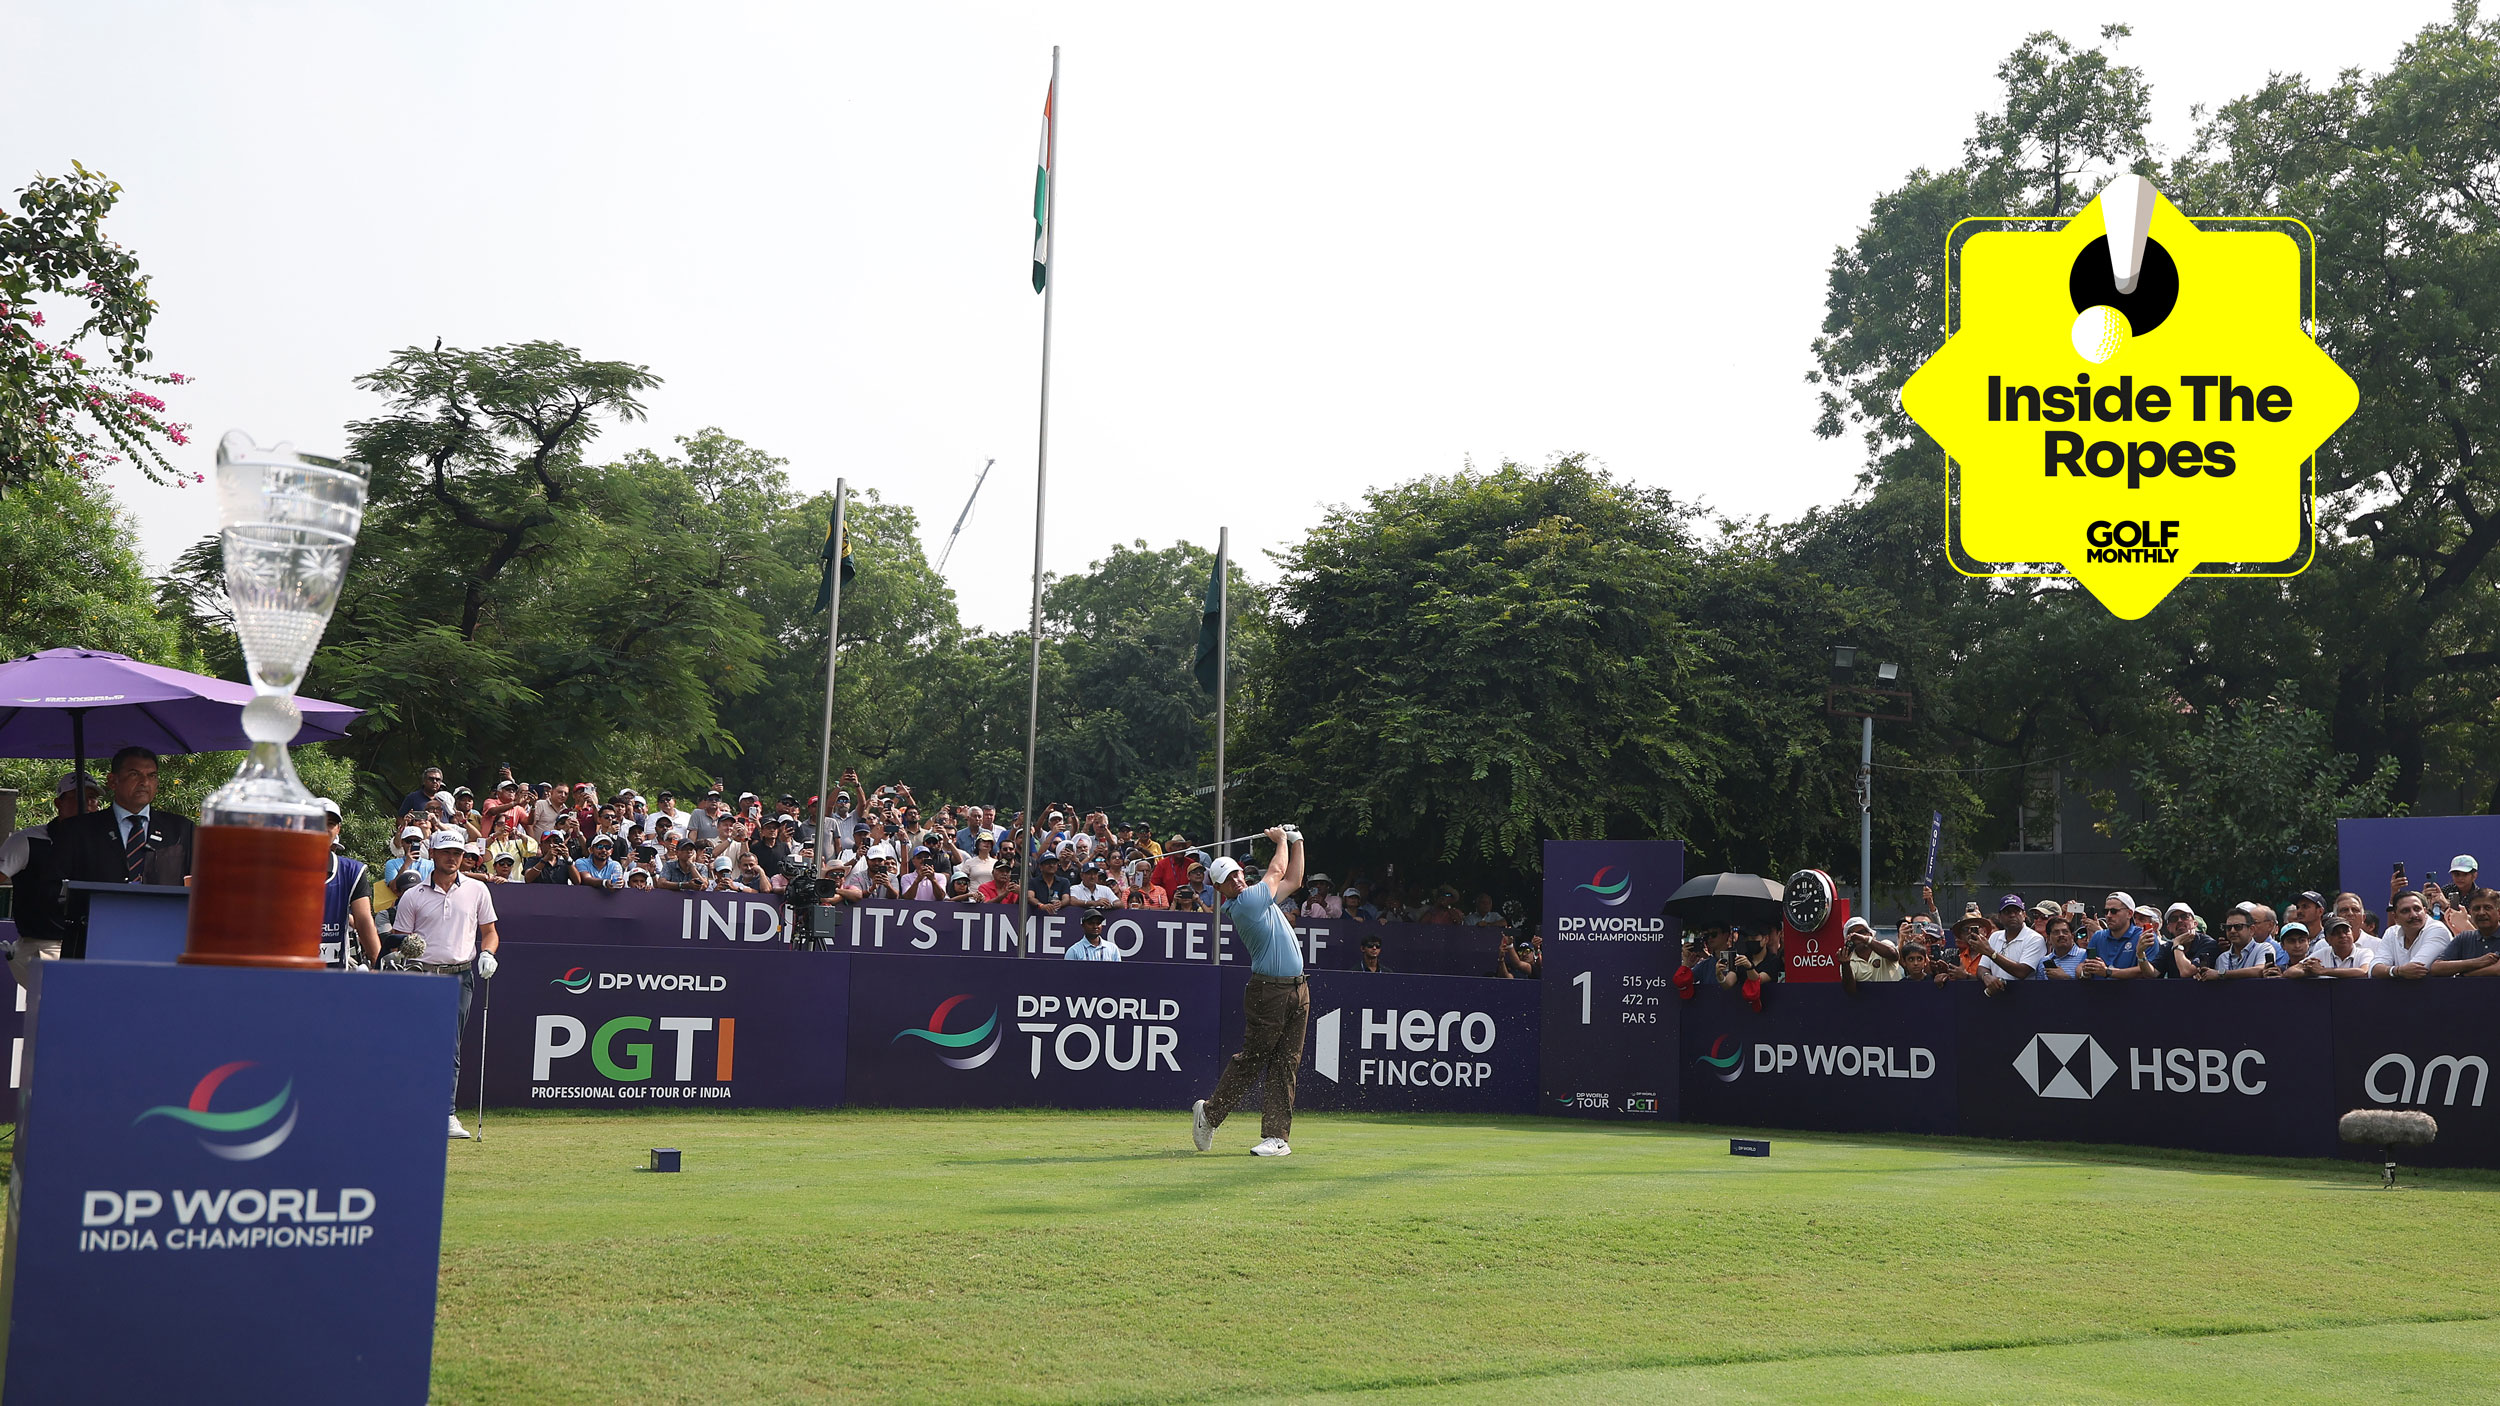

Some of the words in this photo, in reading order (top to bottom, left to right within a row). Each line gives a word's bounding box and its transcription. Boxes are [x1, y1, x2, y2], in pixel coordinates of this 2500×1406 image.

[1927, 829, 1938, 874] QUIET
[321, 923, 340, 932] RLD
[682, 898, 834, 945] INDI
[851, 907, 938, 950] IT'S
[953, 911, 1067, 955] TIME
[1157, 921, 1233, 961] TEE
[1558, 917, 1586, 932] DP
[1588, 917, 1664, 932] WORLD
[1558, 932, 1586, 941] INDIA
[1587, 932, 1664, 942] CHAMPIONSHIP
[1792, 954, 1835, 968] OMEGA
[598, 973, 633, 990] DP
[636, 974, 727, 992] WORLD
[1622, 975, 1642, 988] 515
[1645, 976, 1667, 990] yds
[1017, 995, 1061, 1018] DP
[1065, 996, 1180, 1021] WORLD
[1572, 971, 1592, 1025] 1
[1621, 994, 1643, 1006] 472
[1646, 997, 1659, 1006] m
[1360, 1008, 1496, 1054] Hero
[1622, 1012, 1646, 1024] PAR
[1649, 1013, 1657, 1024] 5
[532, 1014, 736, 1082] PGTI
[1017, 1023, 1182, 1080] TOUR
[1754, 1043, 1798, 1074] DP
[1802, 1044, 1936, 1079] WORLD
[1359, 1059, 1492, 1087] FINCORP
[2129, 1047, 2268, 1096] HSBC
[531, 1086, 616, 1099] PROFESSIONAL
[618, 1086, 648, 1099] GOLF
[649, 1087, 680, 1098] TOUR
[682, 1087, 698, 1098] OF
[699, 1087, 732, 1098] INDIA
[1577, 1098, 1610, 1109] TOUR
[1627, 1099, 1658, 1110] PGTI
[82, 1190, 163, 1226] DP
[172, 1188, 377, 1224] WORLD
[80, 1229, 159, 1251] INDIA
[166, 1225, 374, 1250] CHAMPIONSHIP
